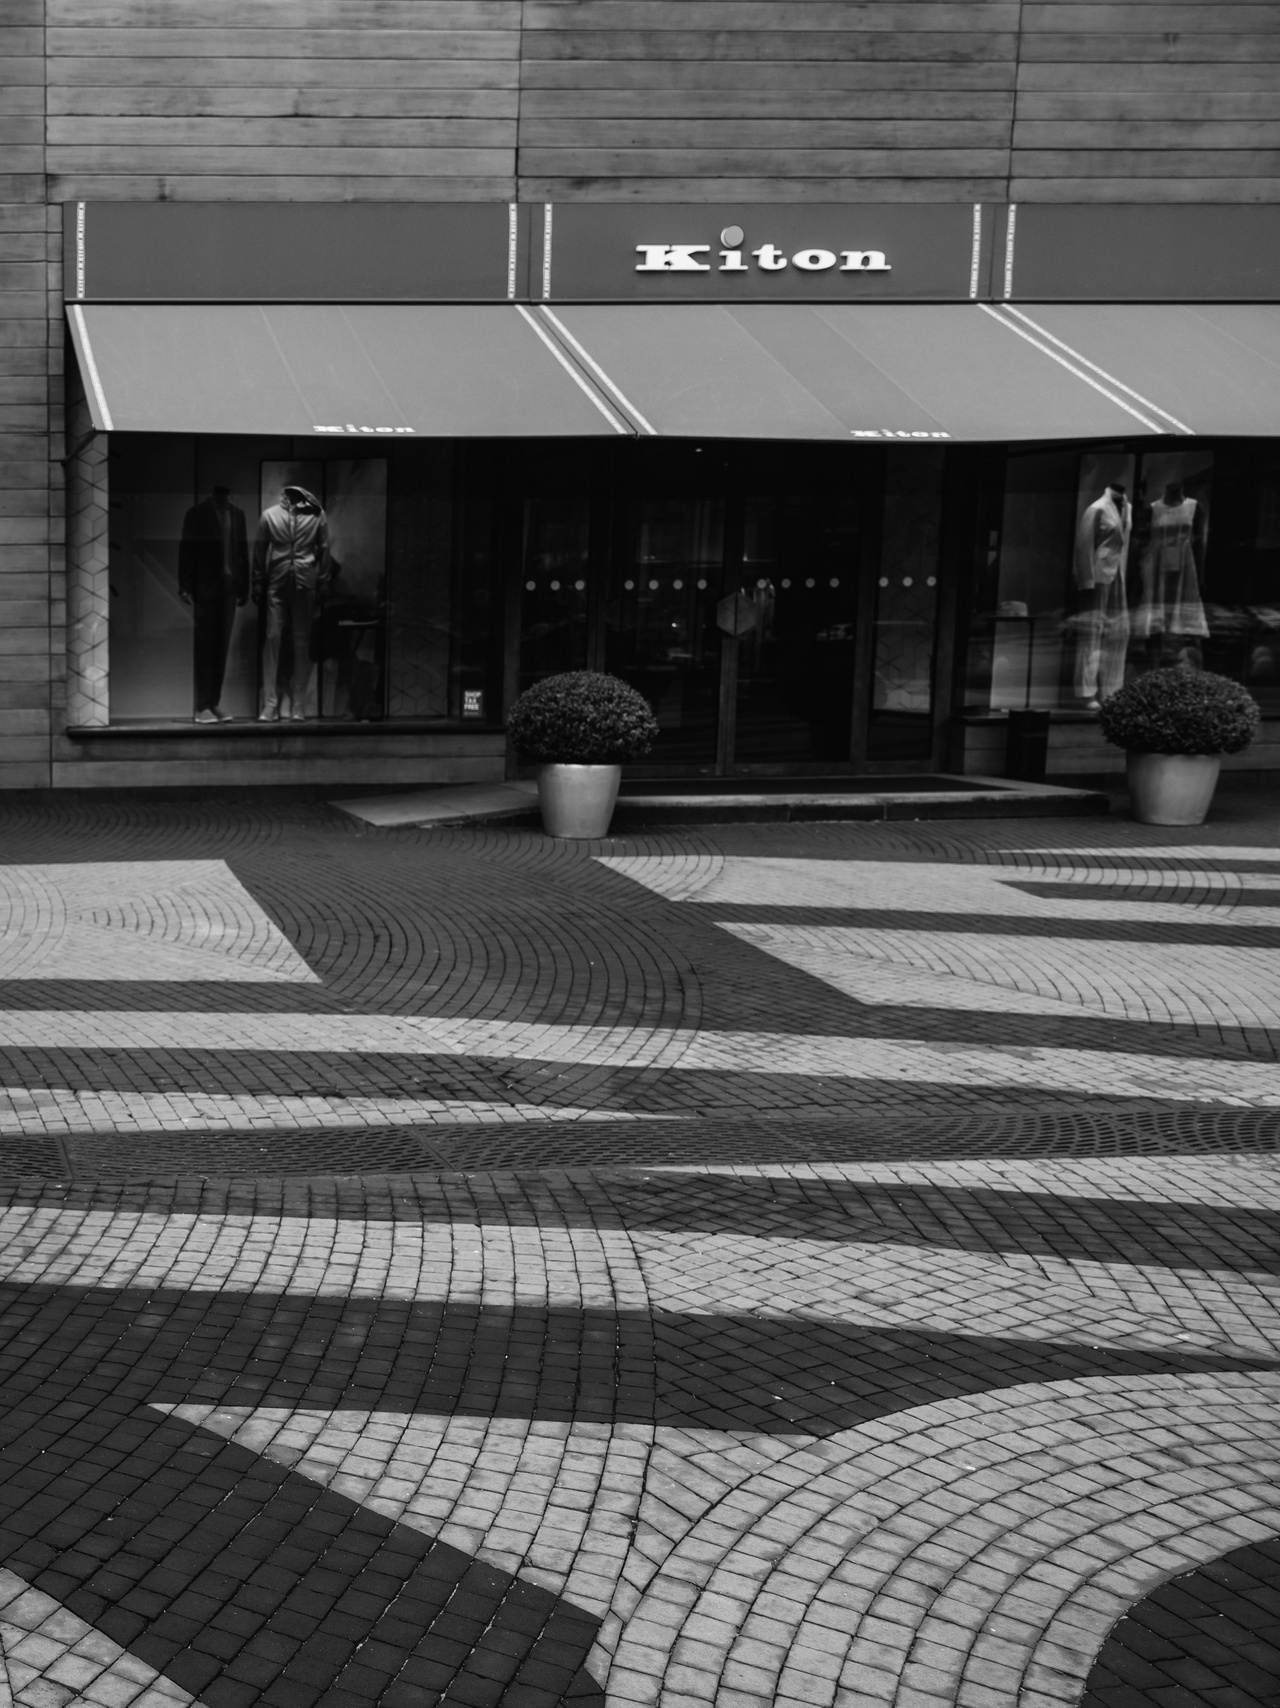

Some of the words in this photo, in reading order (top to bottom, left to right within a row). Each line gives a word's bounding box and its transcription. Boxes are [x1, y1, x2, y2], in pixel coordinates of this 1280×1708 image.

[634, 225, 892, 271] Kiton
[312, 423, 416, 433] Kiton
[849, 428, 952, 438] Kiton
